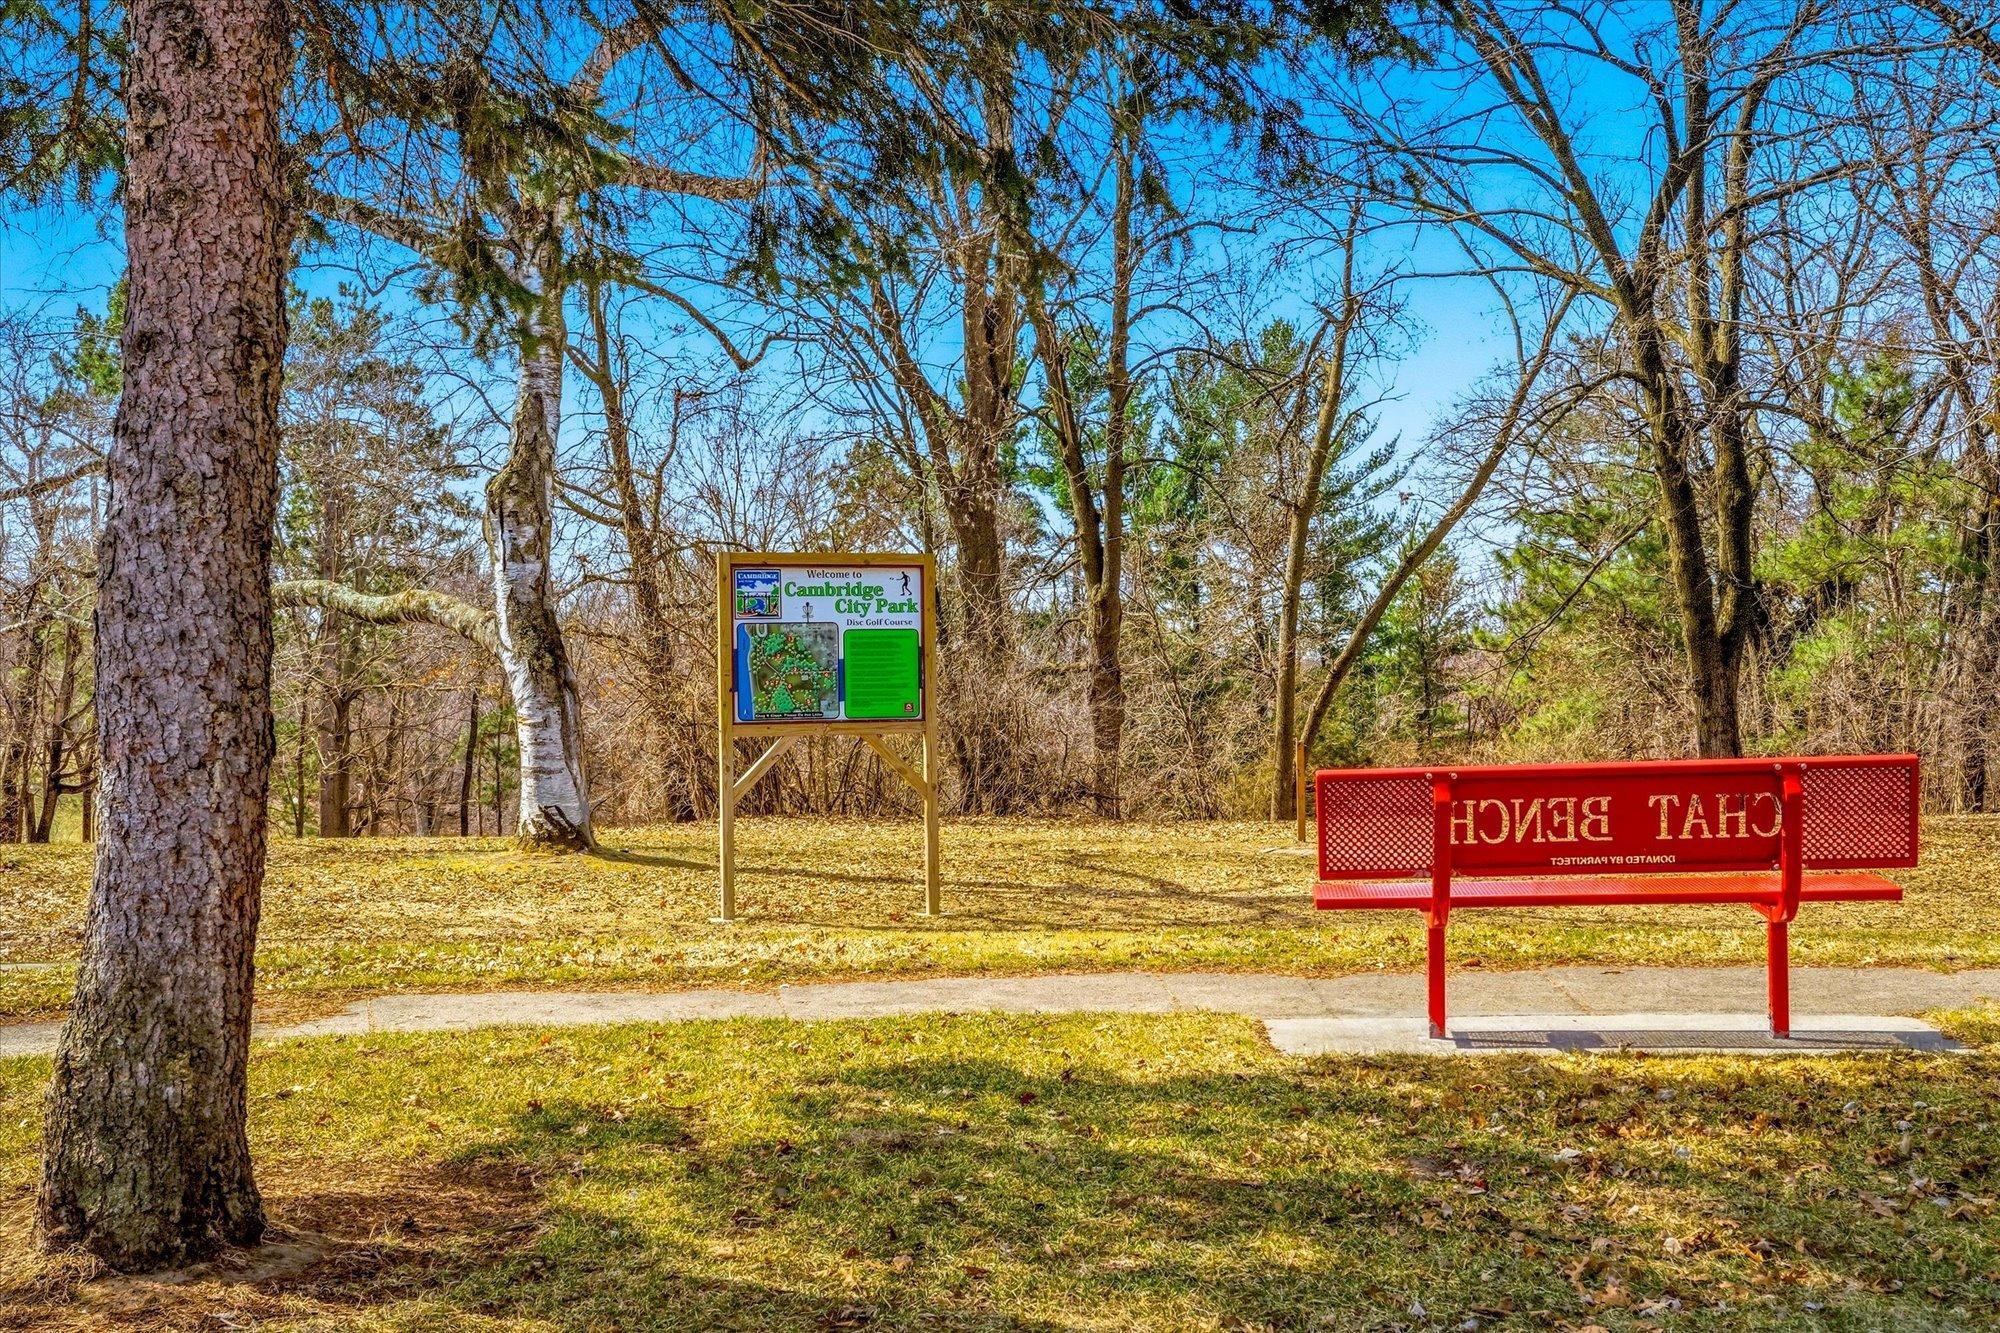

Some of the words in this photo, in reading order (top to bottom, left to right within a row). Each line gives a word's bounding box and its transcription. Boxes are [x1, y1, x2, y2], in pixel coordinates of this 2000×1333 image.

[737, 572, 778, 580] CAMBRIDGE
[806, 570, 850, 579] Welcome
[852, 570, 862, 578] to
[784, 581, 884, 601] Cambridge
[834, 598, 872, 618] City
[875, 597, 919, 613] Park
[846, 618, 864, 626] Disc
[865, 618, 884, 626] Golf
[885, 618, 913, 626] Course
